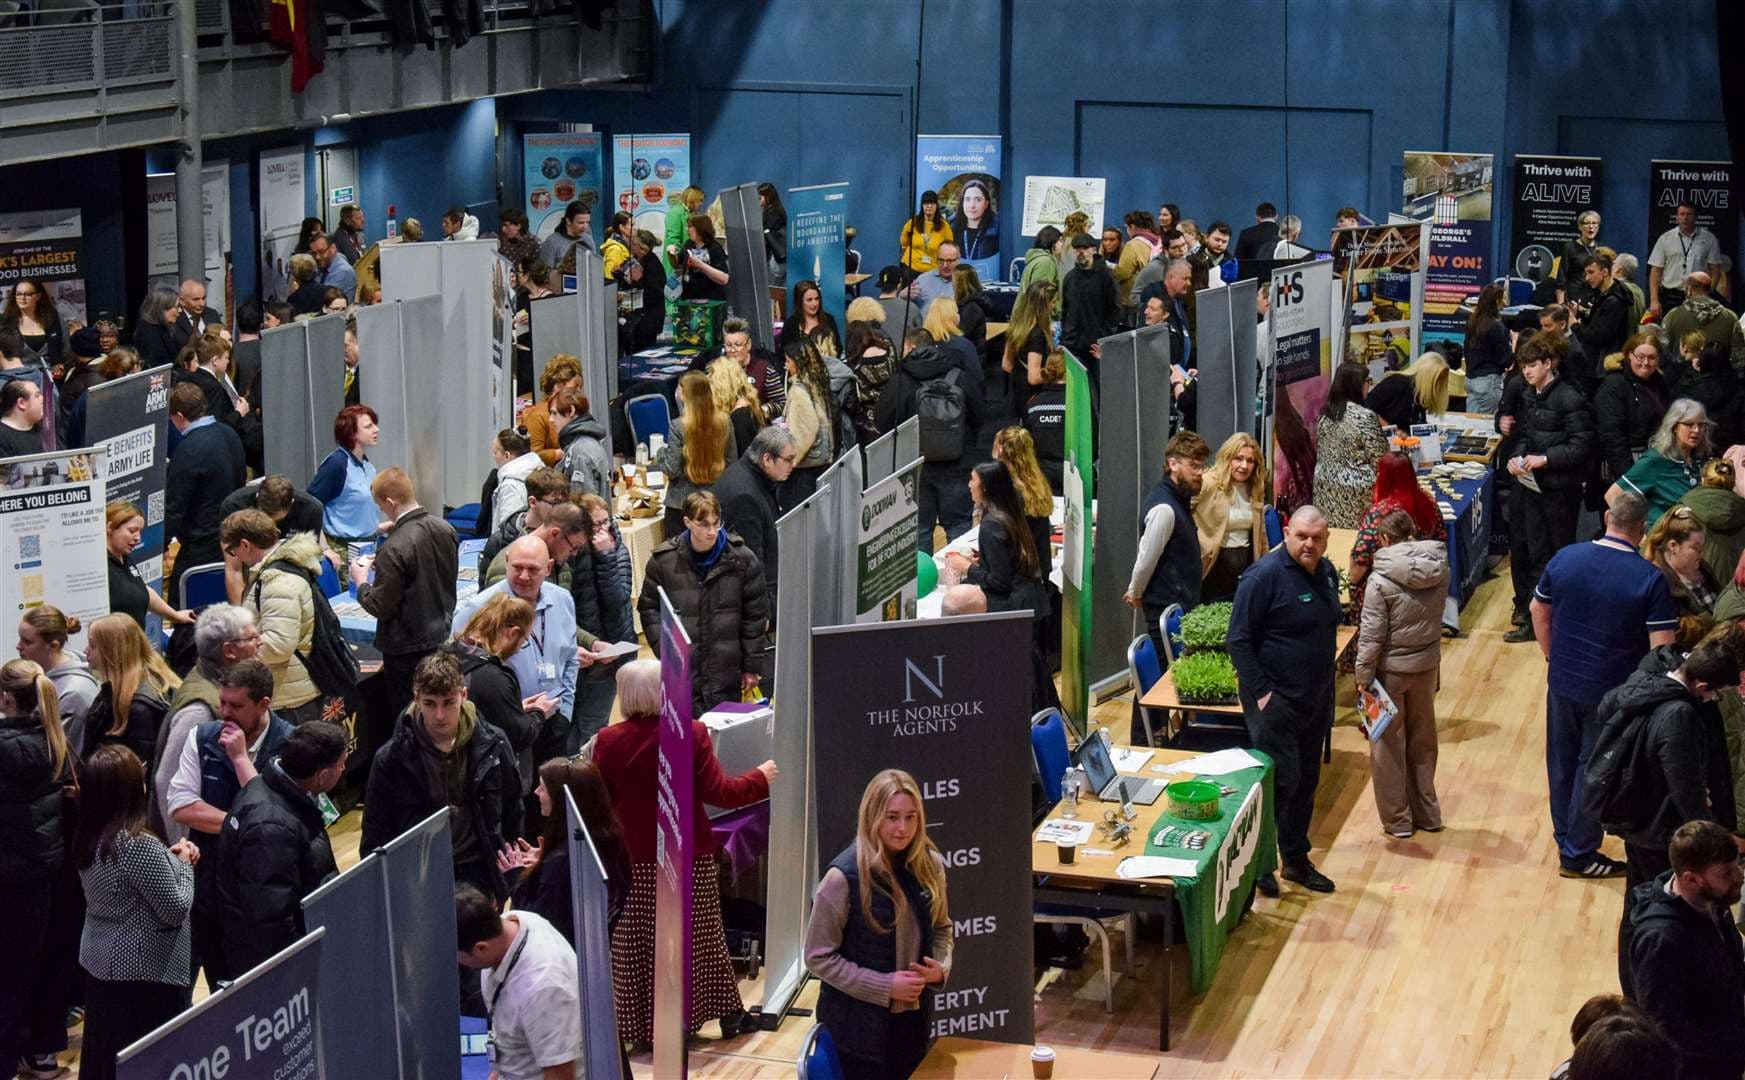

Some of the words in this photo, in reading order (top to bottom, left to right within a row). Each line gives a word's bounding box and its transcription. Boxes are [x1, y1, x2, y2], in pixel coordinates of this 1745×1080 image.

[924, 154, 984, 164] Apprenticeship
[932, 163, 987, 173] Opportunities
[1523, 164, 1562, 176] Thrive
[1564, 166, 1592, 177] with
[1659, 169, 1700, 181] Thrive
[1701, 170, 1729, 182] with
[1521, 183, 1592, 204] ALIVE
[797, 215, 828, 227] REDEFINE
[830, 214, 841, 223] THE
[797, 224, 837, 238] BOUNDARIES
[1432, 228, 1472, 236] GEORGE'S
[797, 239, 805, 248] OF
[807, 235, 839, 246] AMBITION
[21, 251, 76, 266] LARGEST
[1427, 256, 1449, 268] AY
[1452, 256, 1482, 270] ON!
[21, 264, 77, 277] BUSINESSES
[1275, 271, 1304, 308] HS
[1275, 338, 1292, 353] Legal
[1291, 334, 1312, 347] matters
[146, 388, 168, 408] ARMY
[114, 431, 153, 455] BENEFITS
[108, 455, 134, 477] ARMY
[135, 449, 151, 467] LIFE
[25, 496, 45, 508] YOU
[48, 490, 88, 505] BELONG
[866, 529, 894, 558] ENGINEERING
[894, 514, 919, 538] EXCELLENCE
[884, 543, 897, 561] FOOD
[897, 531, 918, 553] INDUSTRY
[902, 655, 946, 702] N
[866, 709, 900, 725] THE
[905, 700, 984, 721] NORFOLK
[893, 717, 957, 736] AGENTS
[923, 779, 960, 800] LES
[942, 847, 981, 868] NGS
[954, 916, 997, 938] MES
[934, 986, 988, 1011] ERTY
[169, 1045, 231, 1080] One
[236, 987, 310, 1061] Team
[283, 1018, 312, 1055] exceed
[274, 1041, 313, 1080] customer
